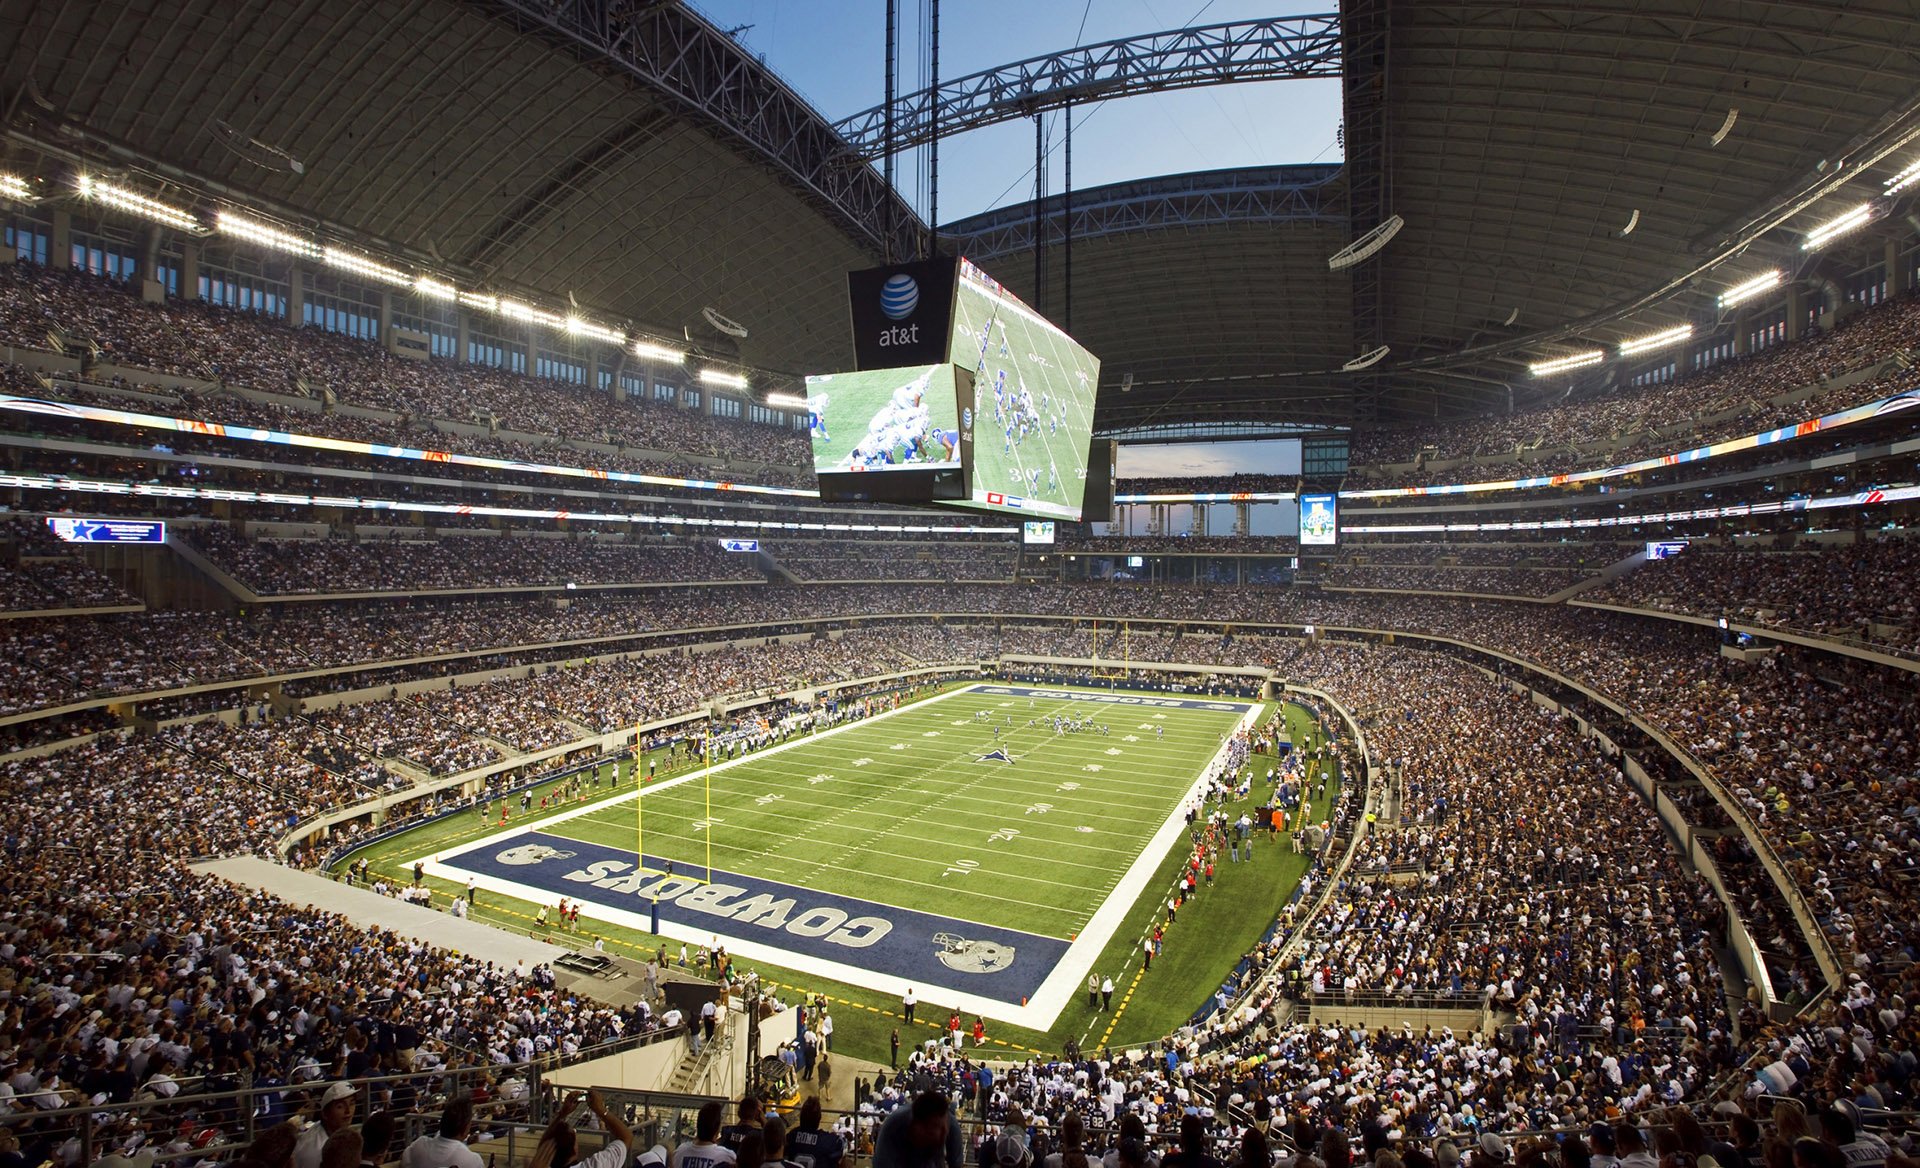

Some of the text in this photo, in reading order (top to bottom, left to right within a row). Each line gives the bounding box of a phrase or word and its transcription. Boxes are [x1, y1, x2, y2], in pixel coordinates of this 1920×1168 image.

[879, 323, 919, 347] at&t
[991, 827, 1022, 842] 20
[945, 859, 980, 876] 10
[561, 860, 894, 948] COWBOYS
[795, 1131, 818, 1146] ROMO
[682, 1156, 714, 1168] WHITE
